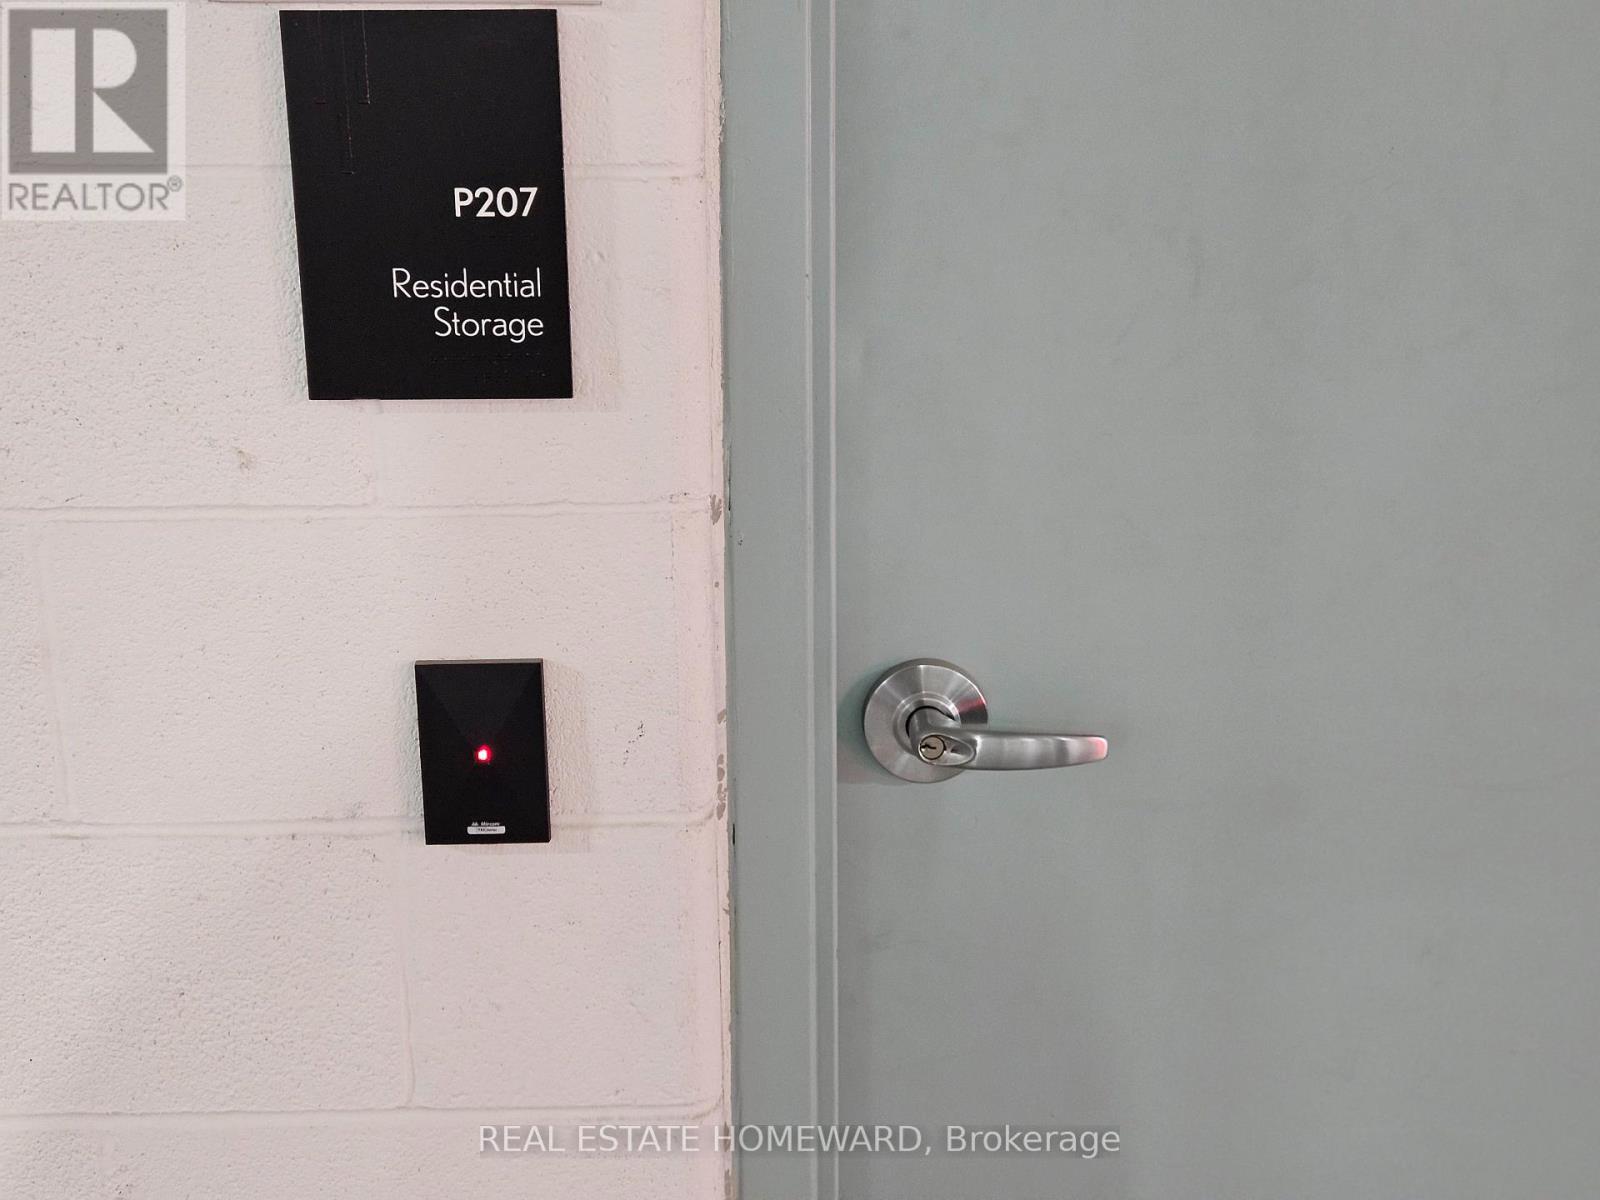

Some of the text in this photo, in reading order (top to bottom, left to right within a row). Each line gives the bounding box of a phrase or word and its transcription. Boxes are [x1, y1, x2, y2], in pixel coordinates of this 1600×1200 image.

[453, 186, 538, 218] P207
[391, 266, 542, 299] Residential
[433, 306, 544, 344] Storage
